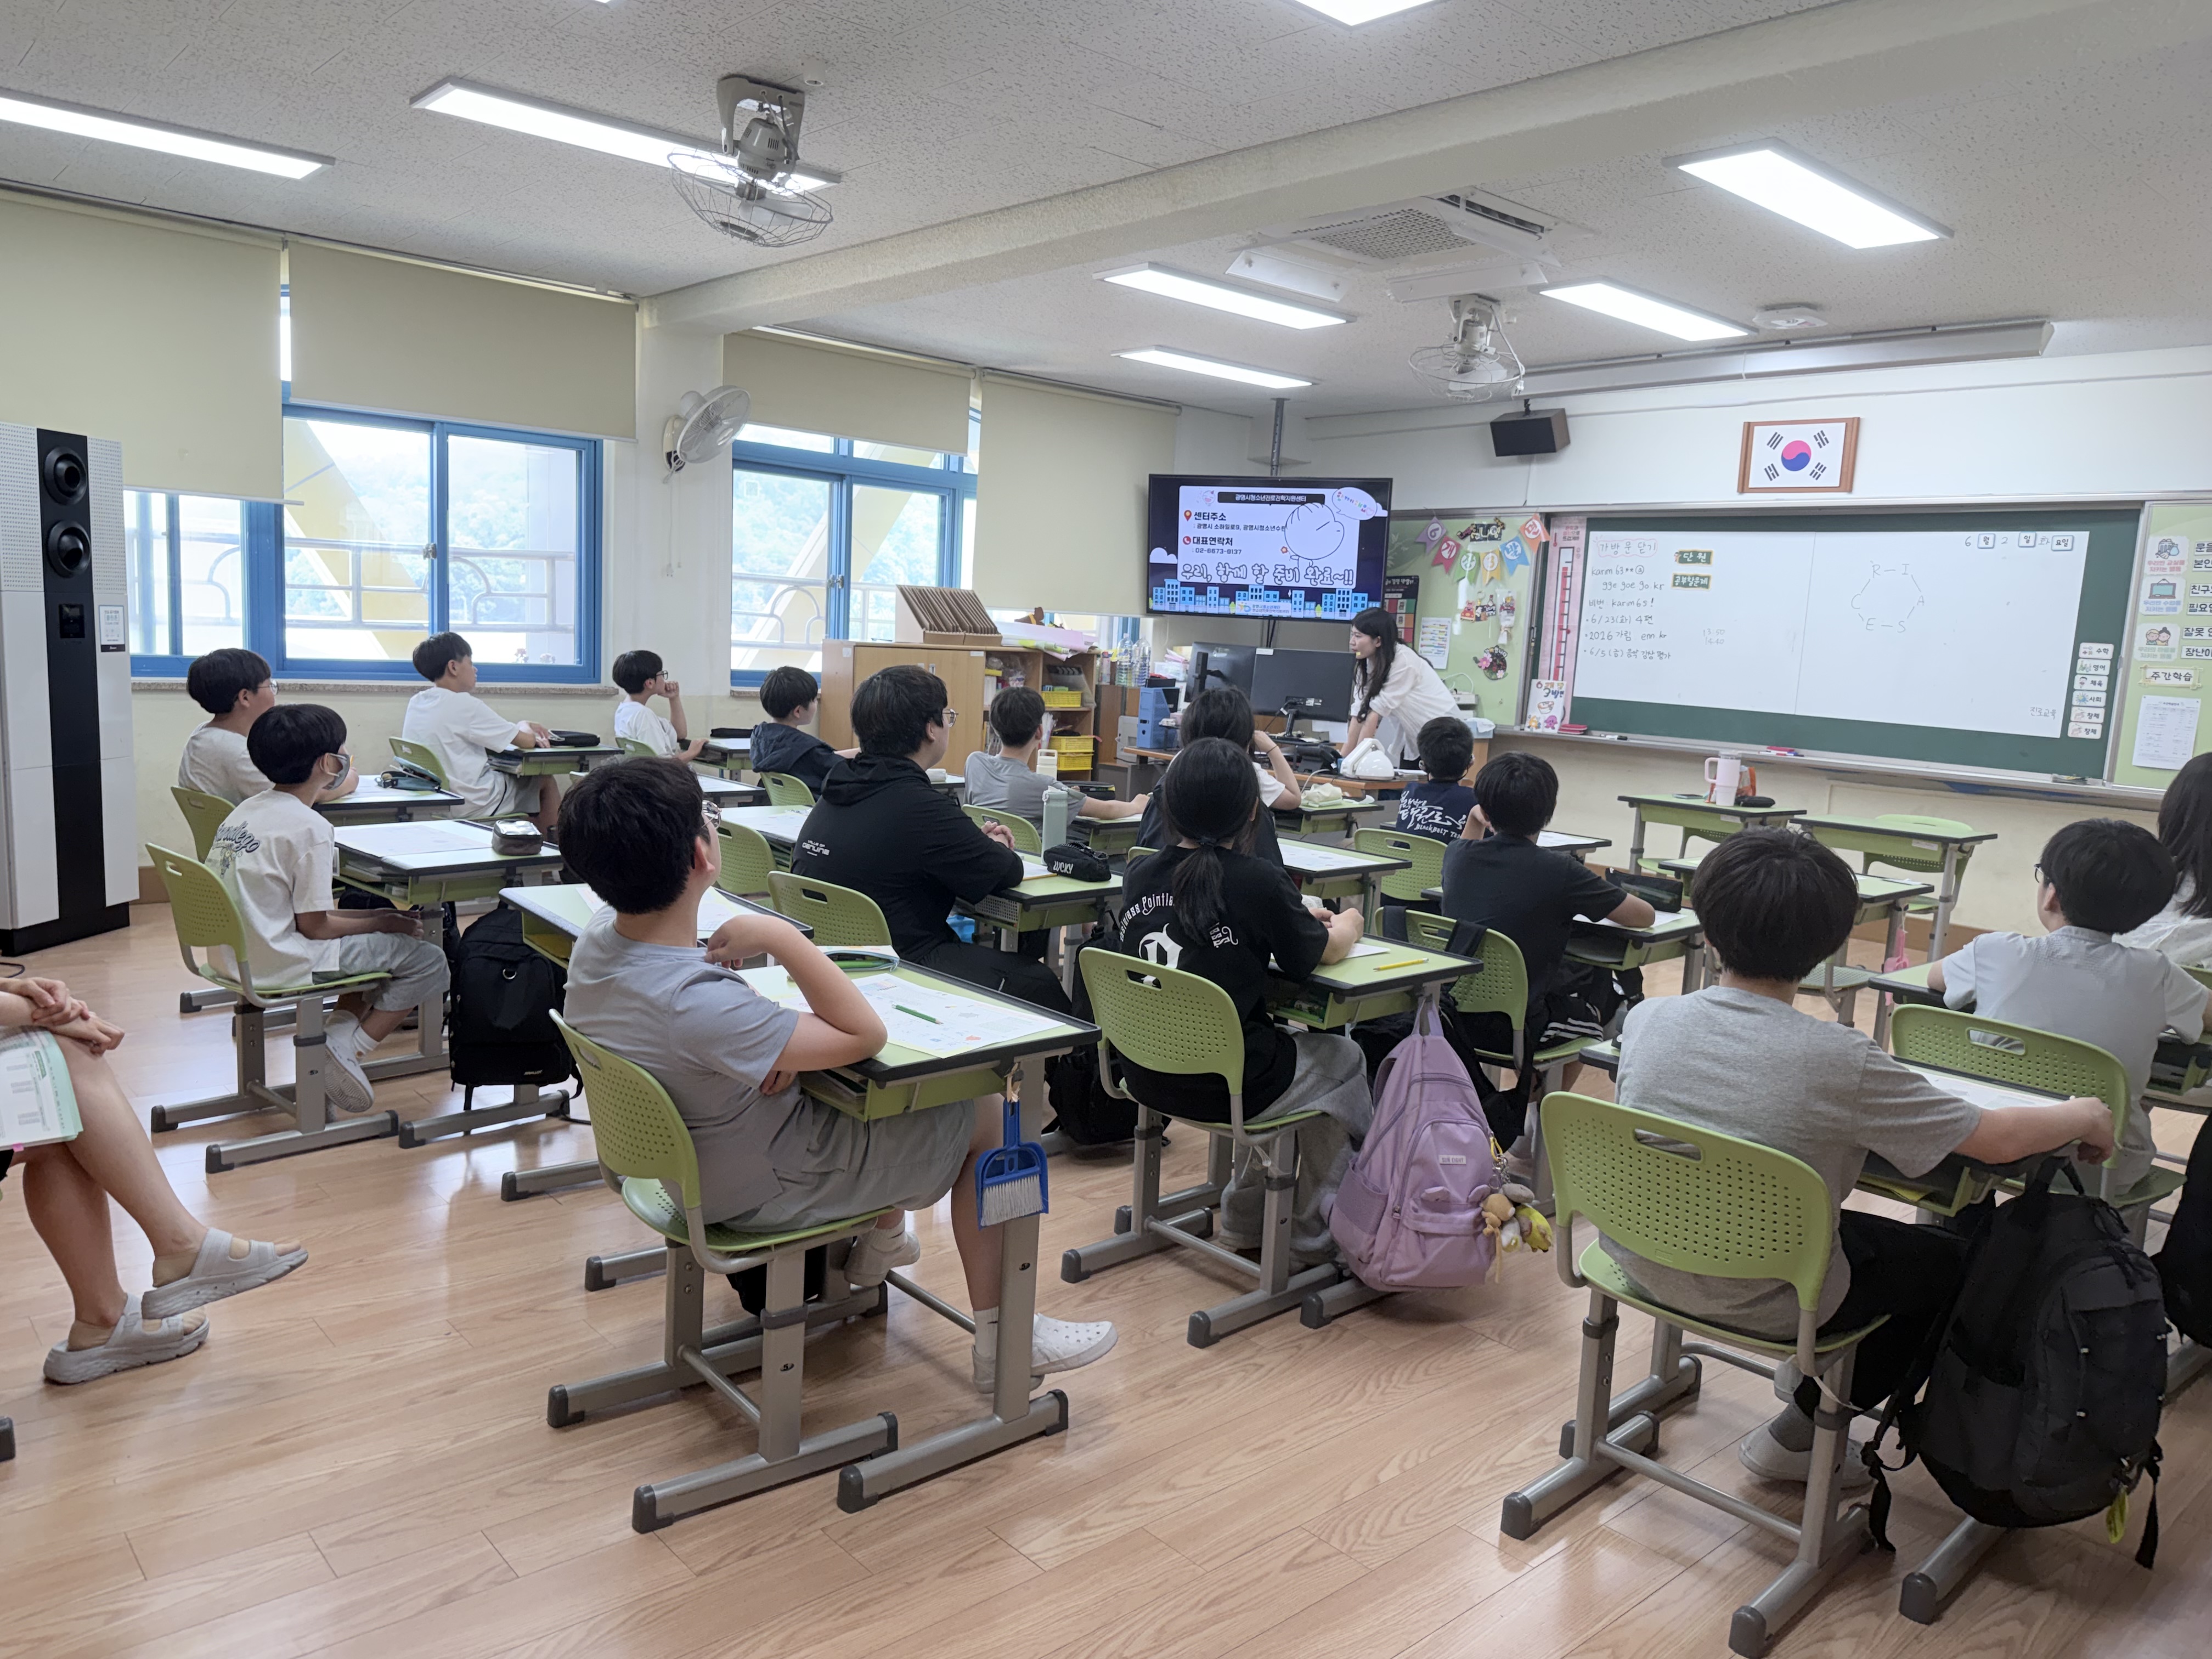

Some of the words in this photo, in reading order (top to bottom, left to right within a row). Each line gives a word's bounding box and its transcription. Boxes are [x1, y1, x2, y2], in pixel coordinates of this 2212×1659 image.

[1194, 511, 1227, 521] 센터주소
[1192, 536, 1233, 546] 대표연락처
[1965, 535, 1971, 547] 6
[2001, 537, 2008, 545] 2
[2024, 535, 2030, 544] 일
[2055, 539, 2069, 548] 요일
[1273, 564, 1300, 585] 준비
[1871, 564, 1881, 578] R
[1901, 563, 1910, 575] I
[1674, 575, 1708, 587] 공부할문제
[2191, 585, 2212, 594] 친구
[1851, 594, 1861, 610] C
[1916, 595, 1925, 606] A
[1865, 618, 1876, 631] E
[1897, 620, 1906, 633] S
[2184, 627, 2204, 637] 잘못
[2151, 671, 2193, 681] 주간학습
[1053, 860, 1074, 874] LUCKY
[1142, 893, 1175, 916] Pointle
